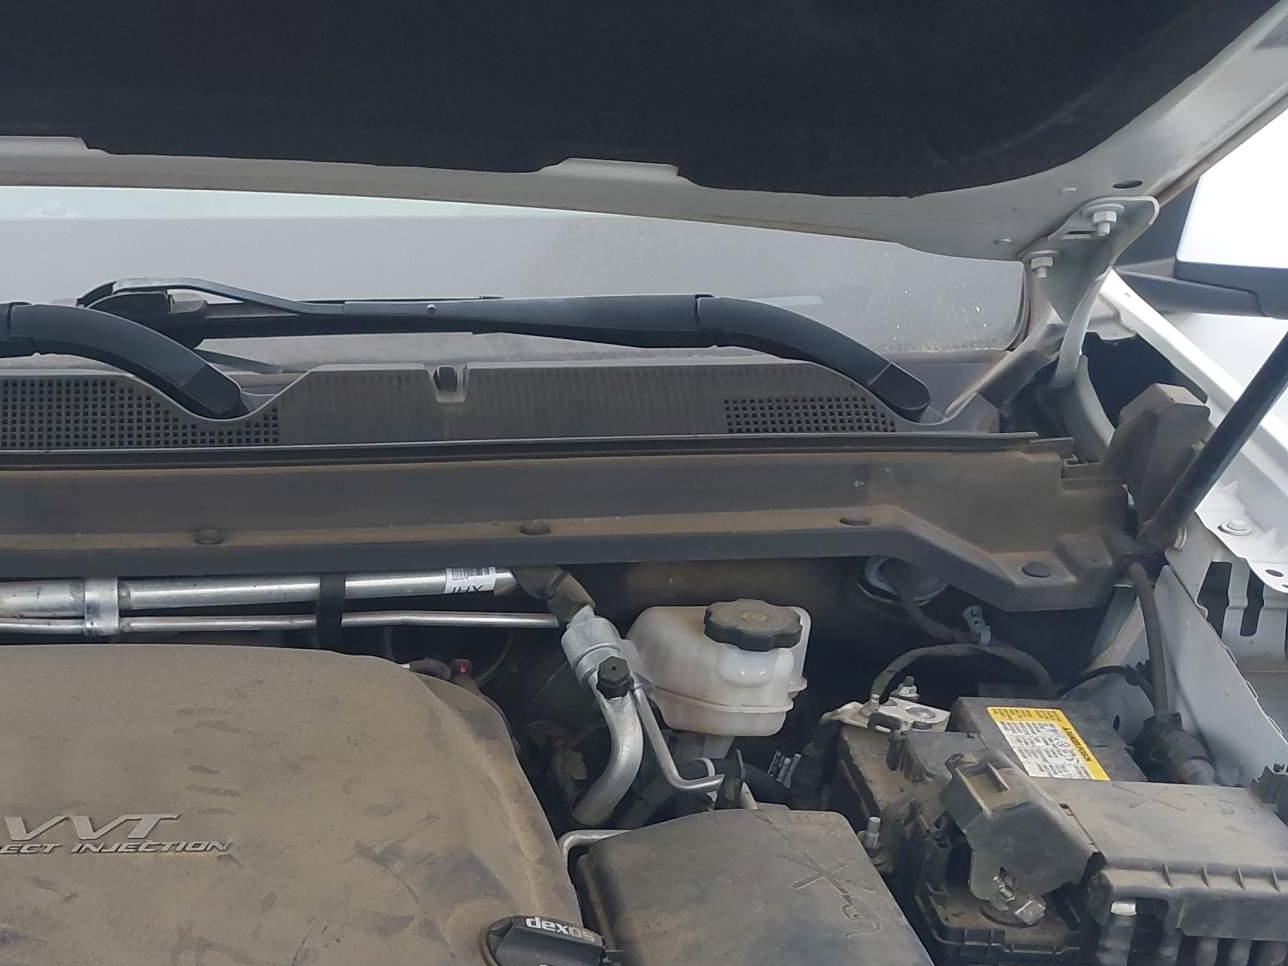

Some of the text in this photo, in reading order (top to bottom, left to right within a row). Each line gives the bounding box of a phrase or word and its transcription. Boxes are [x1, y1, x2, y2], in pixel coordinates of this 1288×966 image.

[4, 814, 181, 841] VVT
[71, 839, 233, 854] INJECTION
[525, 916, 596, 943] dexos
